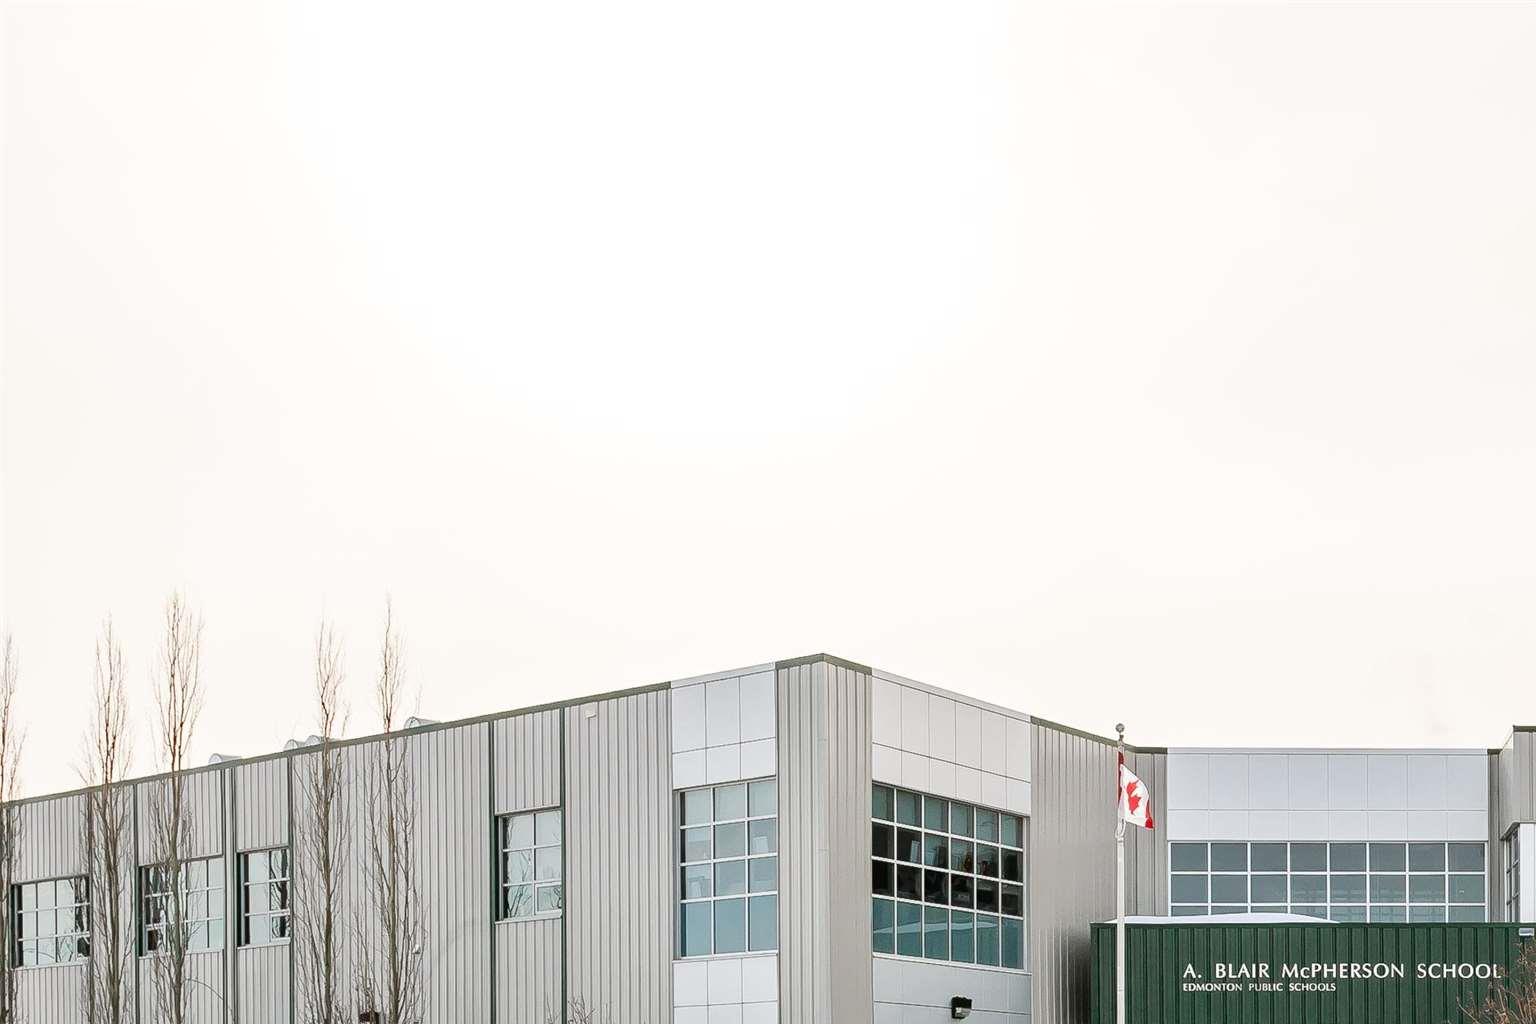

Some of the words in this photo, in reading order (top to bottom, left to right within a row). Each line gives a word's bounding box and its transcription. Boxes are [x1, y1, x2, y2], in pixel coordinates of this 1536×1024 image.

[1183, 963, 1202, 979] A.
[1215, 963, 1270, 979] BLAIR
[1281, 963, 1405, 979] McPHERSON
[1417, 963, 1502, 979] SCHOOL
[1182, 982, 1243, 992] EDMONTON
[1249, 982, 1284, 992] PUBLIC
[1289, 982, 1337, 992] SCHOOLS
